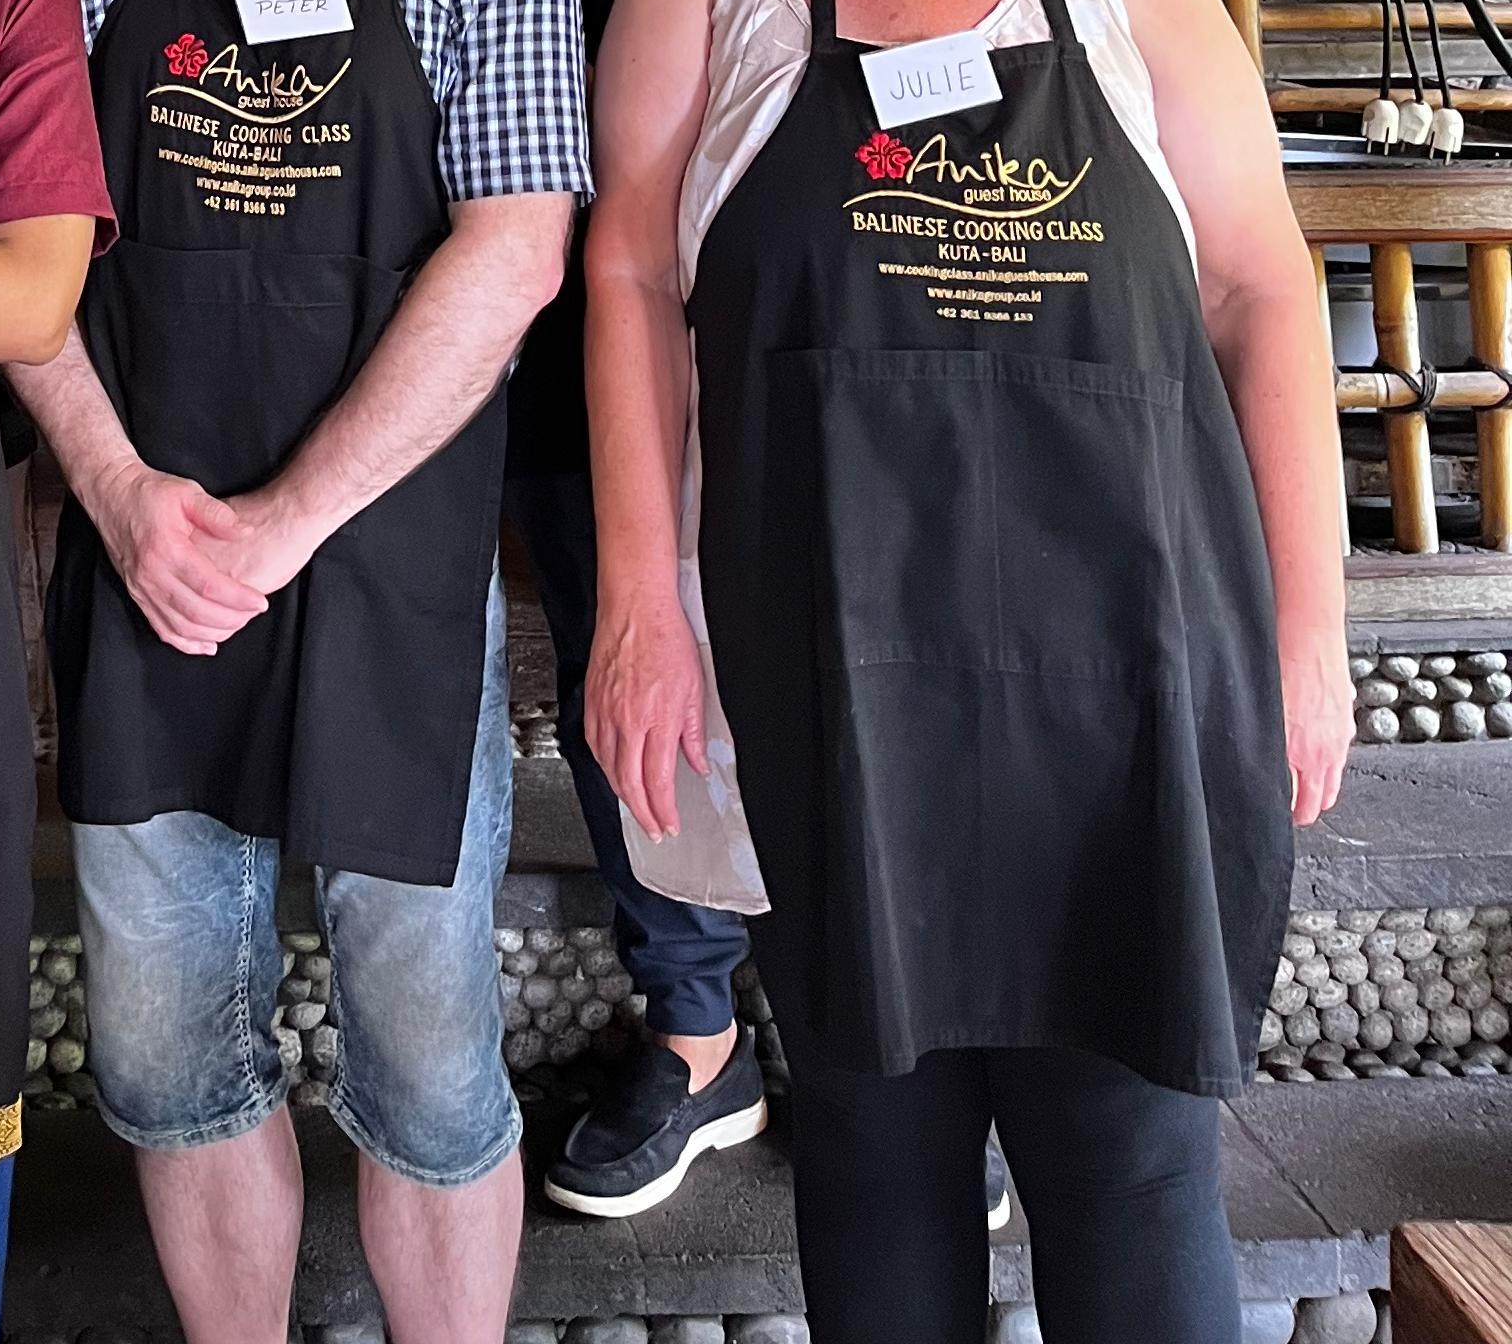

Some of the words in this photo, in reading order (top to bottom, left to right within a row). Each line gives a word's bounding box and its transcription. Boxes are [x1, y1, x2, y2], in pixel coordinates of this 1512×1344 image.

[199, 44, 323, 96] Anika
[890, 59, 976, 100] JULIE
[238, 95, 271, 109] guest
[274, 94, 304, 107] house
[150, 106, 221, 138] BALINESE
[229, 125, 292, 144] COOKING
[302, 124, 351, 144] CLASS
[906, 133, 1069, 189] Anika
[964, 187, 1005, 204] guest
[1010, 187, 1052, 202] house
[852, 211, 948, 238] BALINESE
[953, 220, 1044, 241] COOKING
[1046, 221, 1104, 242] CLASS
